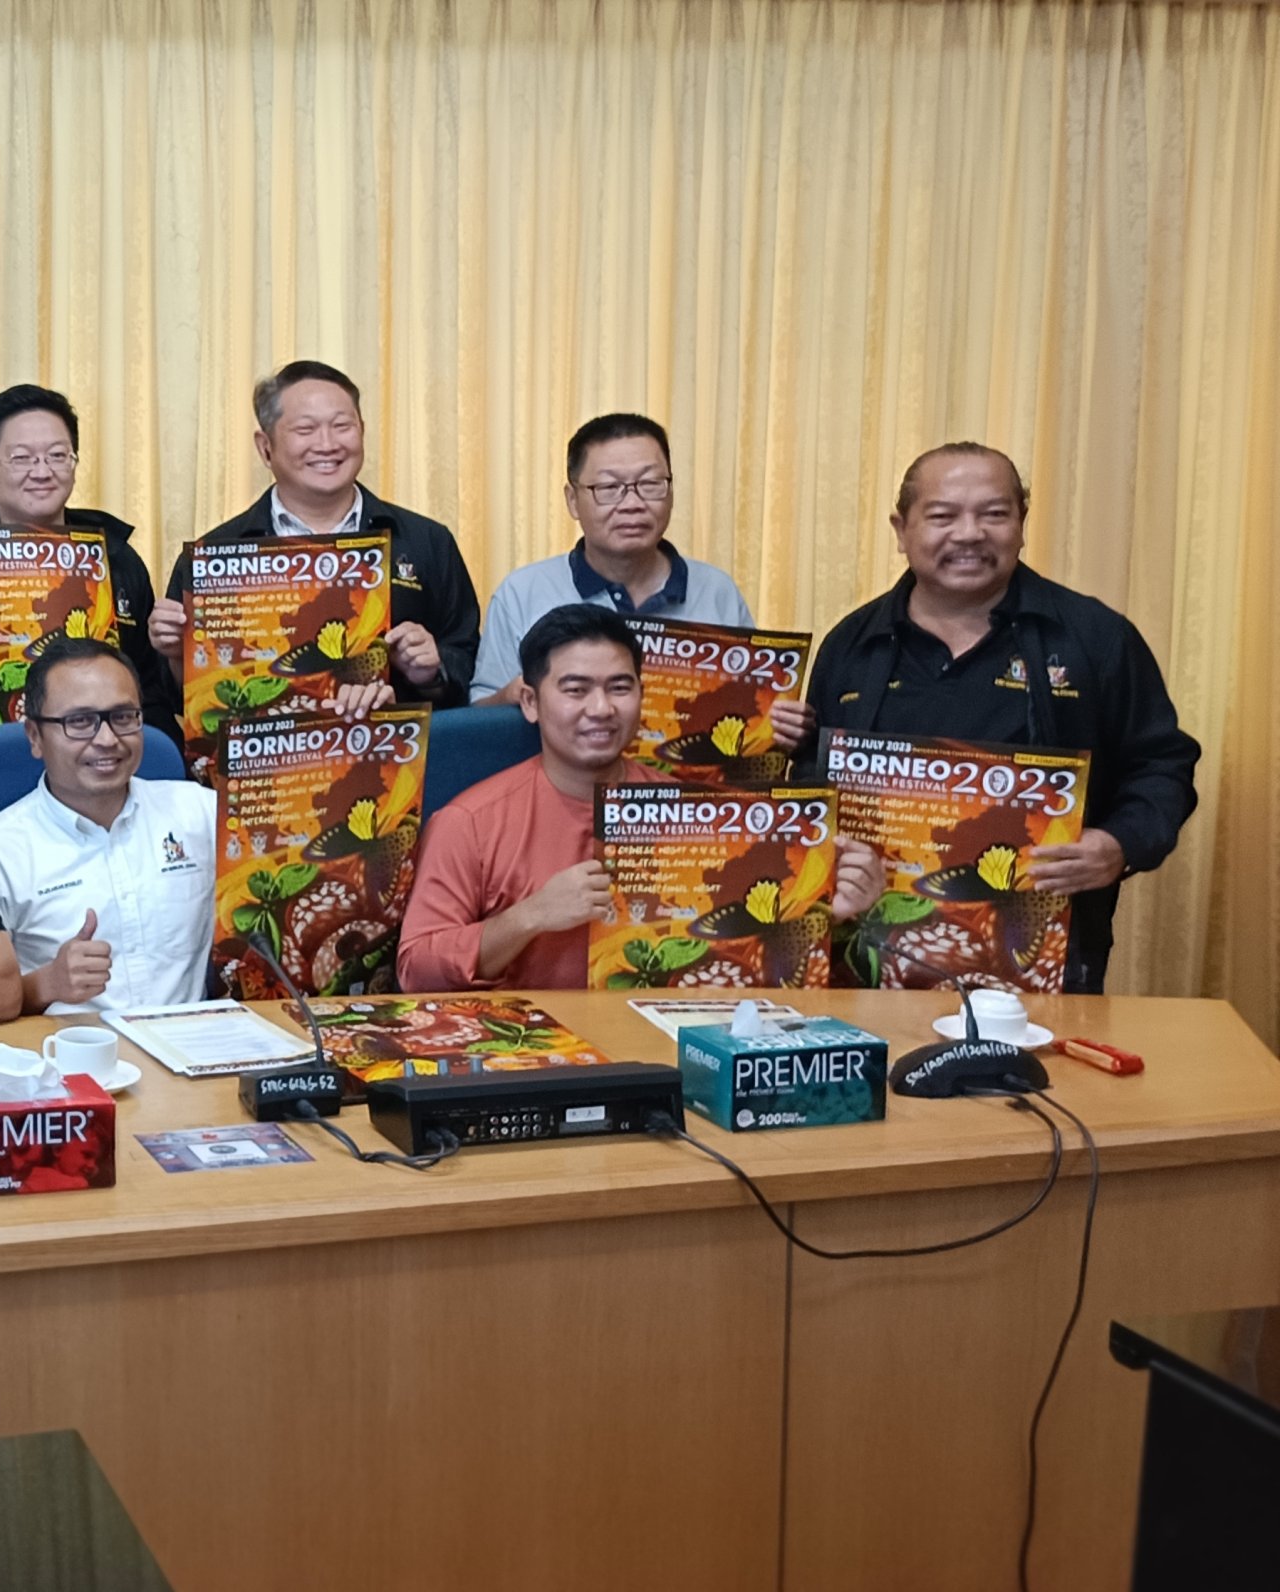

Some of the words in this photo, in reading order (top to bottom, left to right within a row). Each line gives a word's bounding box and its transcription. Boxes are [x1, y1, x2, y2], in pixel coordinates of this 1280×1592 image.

[219, 545, 237, 555] JULY
[238, 544, 258, 554] 2023
[0, 561, 38, 570] FESTIVAL
[193, 555, 290, 577] BORNEO
[193, 578, 243, 588] CULTURAL
[246, 575, 289, 585] FESTIVAL
[645, 655, 692, 668] FESTIVAL
[255, 723, 273, 733] JULY
[275, 720, 294, 730] 2023
[227, 730, 324, 760] BORNEO
[862, 739, 884, 750] JULY
[886, 741, 911, 752] 2023
[228, 757, 279, 770] CULTURAL
[281, 752, 322, 764] FESTIVAL
[829, 750, 951, 780] BORNEO
[828, 771, 888, 787] CULTURAL
[892, 778, 947, 792] FESTIVAL
[634, 789, 655, 799] JULY
[657, 789, 680, 798] 2023
[604, 803, 717, 824] BORNEO
[605, 825, 661, 835] CULTURAL
[664, 824, 715, 834] FESTIVAL
[685, 1044, 720, 1072] PREMIER
[736, 1050, 865, 1089] PREMIER
[759, 1113, 782, 1126] 200
